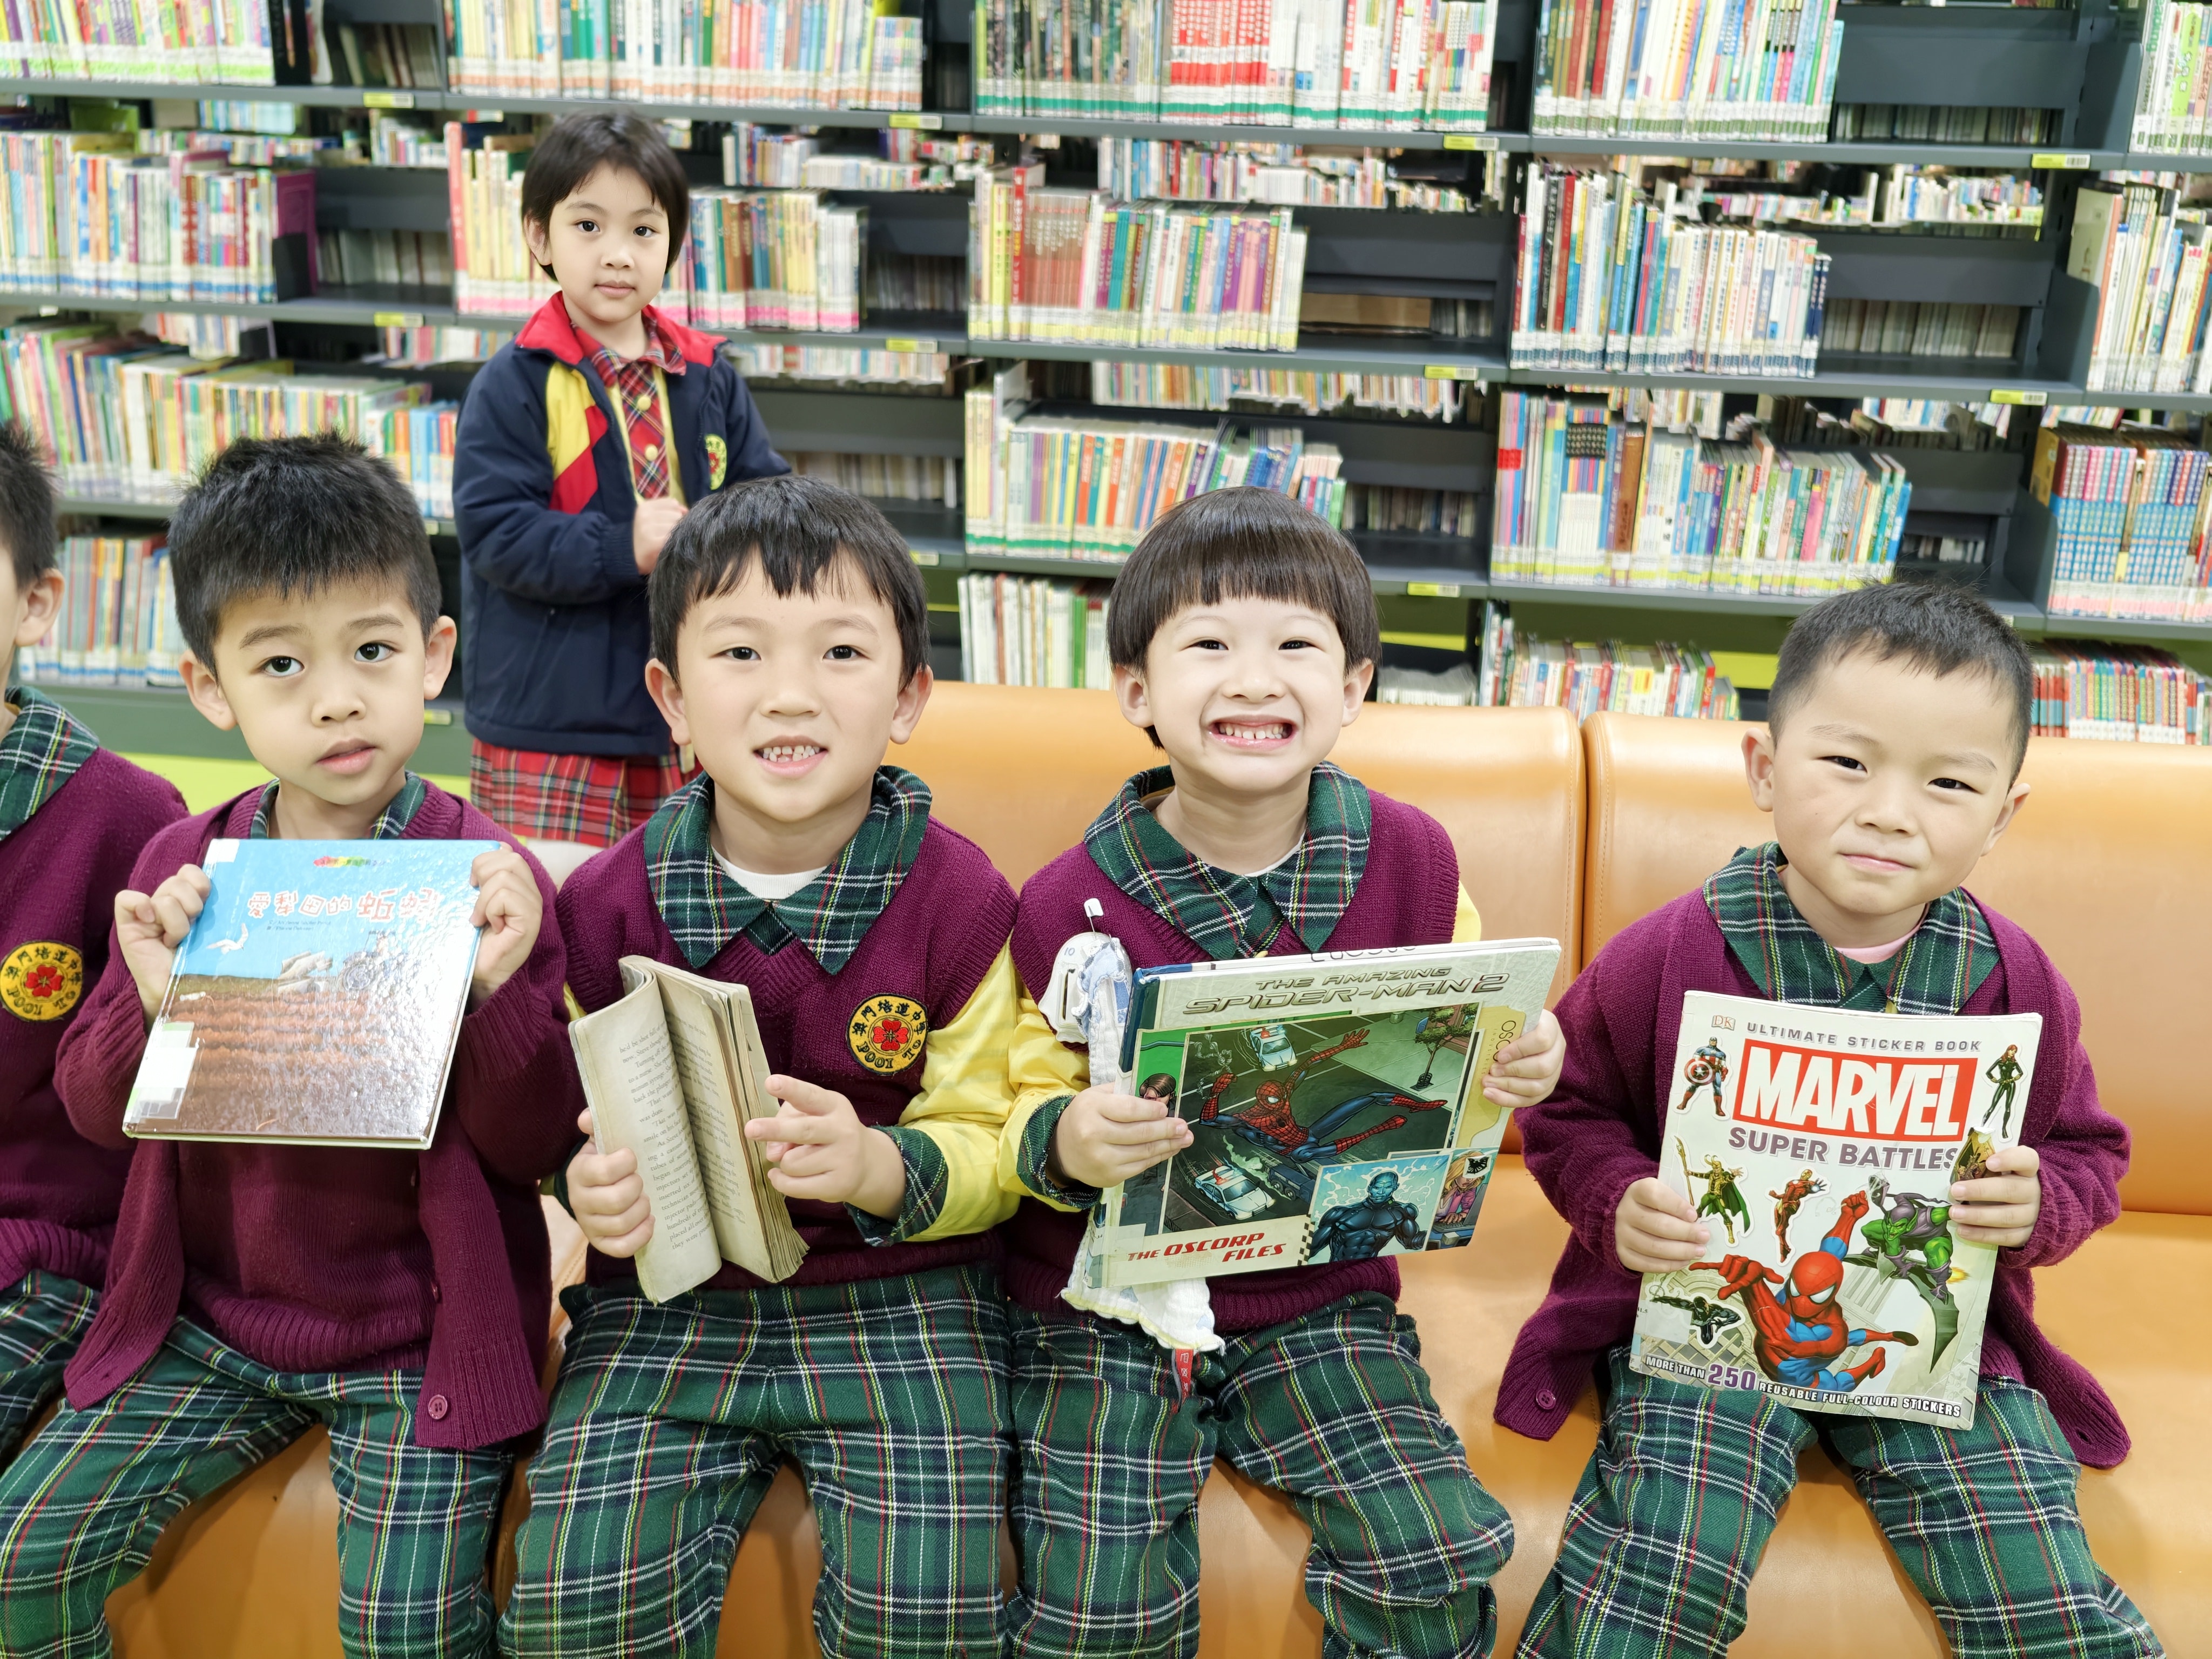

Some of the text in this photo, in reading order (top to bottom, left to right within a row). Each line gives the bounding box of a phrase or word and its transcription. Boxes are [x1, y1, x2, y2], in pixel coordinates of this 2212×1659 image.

[1064, 947, 1075, 956] 10
[1256, 967, 1452, 990] THE AMAZING
[1183, 973, 1510, 1014] SPIDER-MAN 2
[1714, 1015, 1733, 1029] DK
[1747, 1022, 1982, 1051] ULTIMATE STICKER BOOK
[636, 1046, 650, 1056] Steve
[856, 1039, 921, 1069] POOI TO
[635, 1055, 655, 1068] Turning
[633, 1093, 646, 1103] back
[647, 1089, 656, 1097] the
[1739, 1045, 1960, 1136] MARVEL
[643, 1132, 659, 1143] smile
[666, 1134, 678, 1143] Steve
[1728, 1127, 1959, 1170] SUPER BATTLES
[650, 1162, 667, 1171] tubes
[652, 1171, 671, 1181] began
[656, 1177, 680, 1191] injectors
[659, 1186, 682, 1201] inserted
[662, 1194, 689, 1210] technician
[664, 1208, 686, 1220] injector
[666, 1215, 691, 1230] hundreds
[669, 1227, 687, 1242] placed
[695, 1218, 704, 1226] over
[672, 1234, 698, 1250] they were
[1128, 1232, 1265, 1262] THE OSCORP
[1222, 1243, 1287, 1263] FILES
[1645, 1356, 1961, 1418] MORE THAN 250 REUSABLE FULL-COLOUR STICKERS
